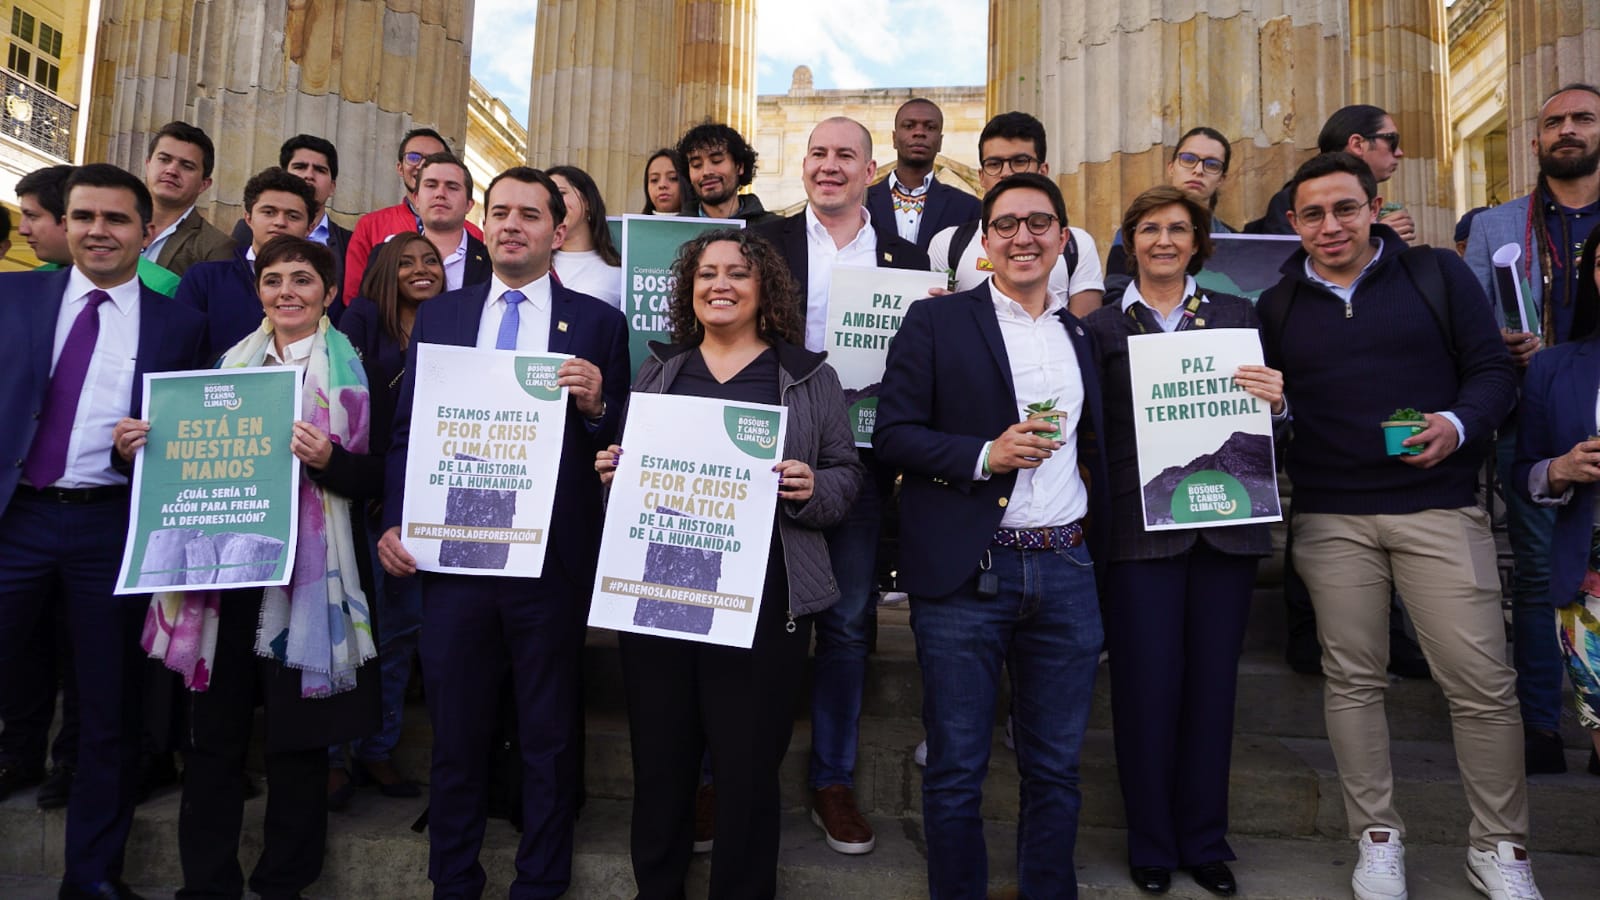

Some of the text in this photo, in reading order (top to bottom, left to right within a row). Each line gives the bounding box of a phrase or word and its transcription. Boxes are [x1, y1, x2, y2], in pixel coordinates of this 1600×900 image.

[633, 294, 643, 311] Y
[872, 293, 902, 310] PAZ
[842, 312, 904, 330] AMBIEN
[1181, 356, 1215, 374] PAZ
[1151, 376, 1246, 400] AMBIENTA
[437, 406, 540, 423] ESTAMOS ANTE LA
[1145, 397, 1261, 423] TERRITORIAL
[177, 414, 263, 439] ESTÁ EN
[738, 417, 769, 427] BOSQUES
[743, 425, 769, 436] CAMBIO
[437, 421, 536, 442] PEOR CRISIS
[166, 437, 272, 460] NUESTRAS
[442, 440, 527, 461] CLIMÁTICA
[182, 459, 255, 480] MANOS
[438, 460, 527, 476] DE LA HISTORIA
[640, 455, 751, 481] ESTAMOS ANTE LA
[429, 474, 533, 490] DE LA HUMANIDAD
[639, 471, 748, 501] PEOR CRISIS
[1188, 484, 1224, 495] BOSQUES
[176, 485, 257, 502] ¿CUÁL SERÍA TÚ
[1189, 493, 1227, 503] Y CAMBIO
[161, 499, 270, 514] ACCIÓN PARA FRENAR
[643, 492, 736, 520] CLIMÁTICA
[163, 511, 267, 527] LA DEFORESTACIÓN?
[639, 513, 735, 537] DE LA HISTORIA
[414, 526, 536, 541] #PAREMOSLADEFORESTACIÓN
[629, 526, 741, 553] DE LA HUMANIDAD
[609, 580, 746, 609] #PAREMOSLADEFORESTACIÓN
